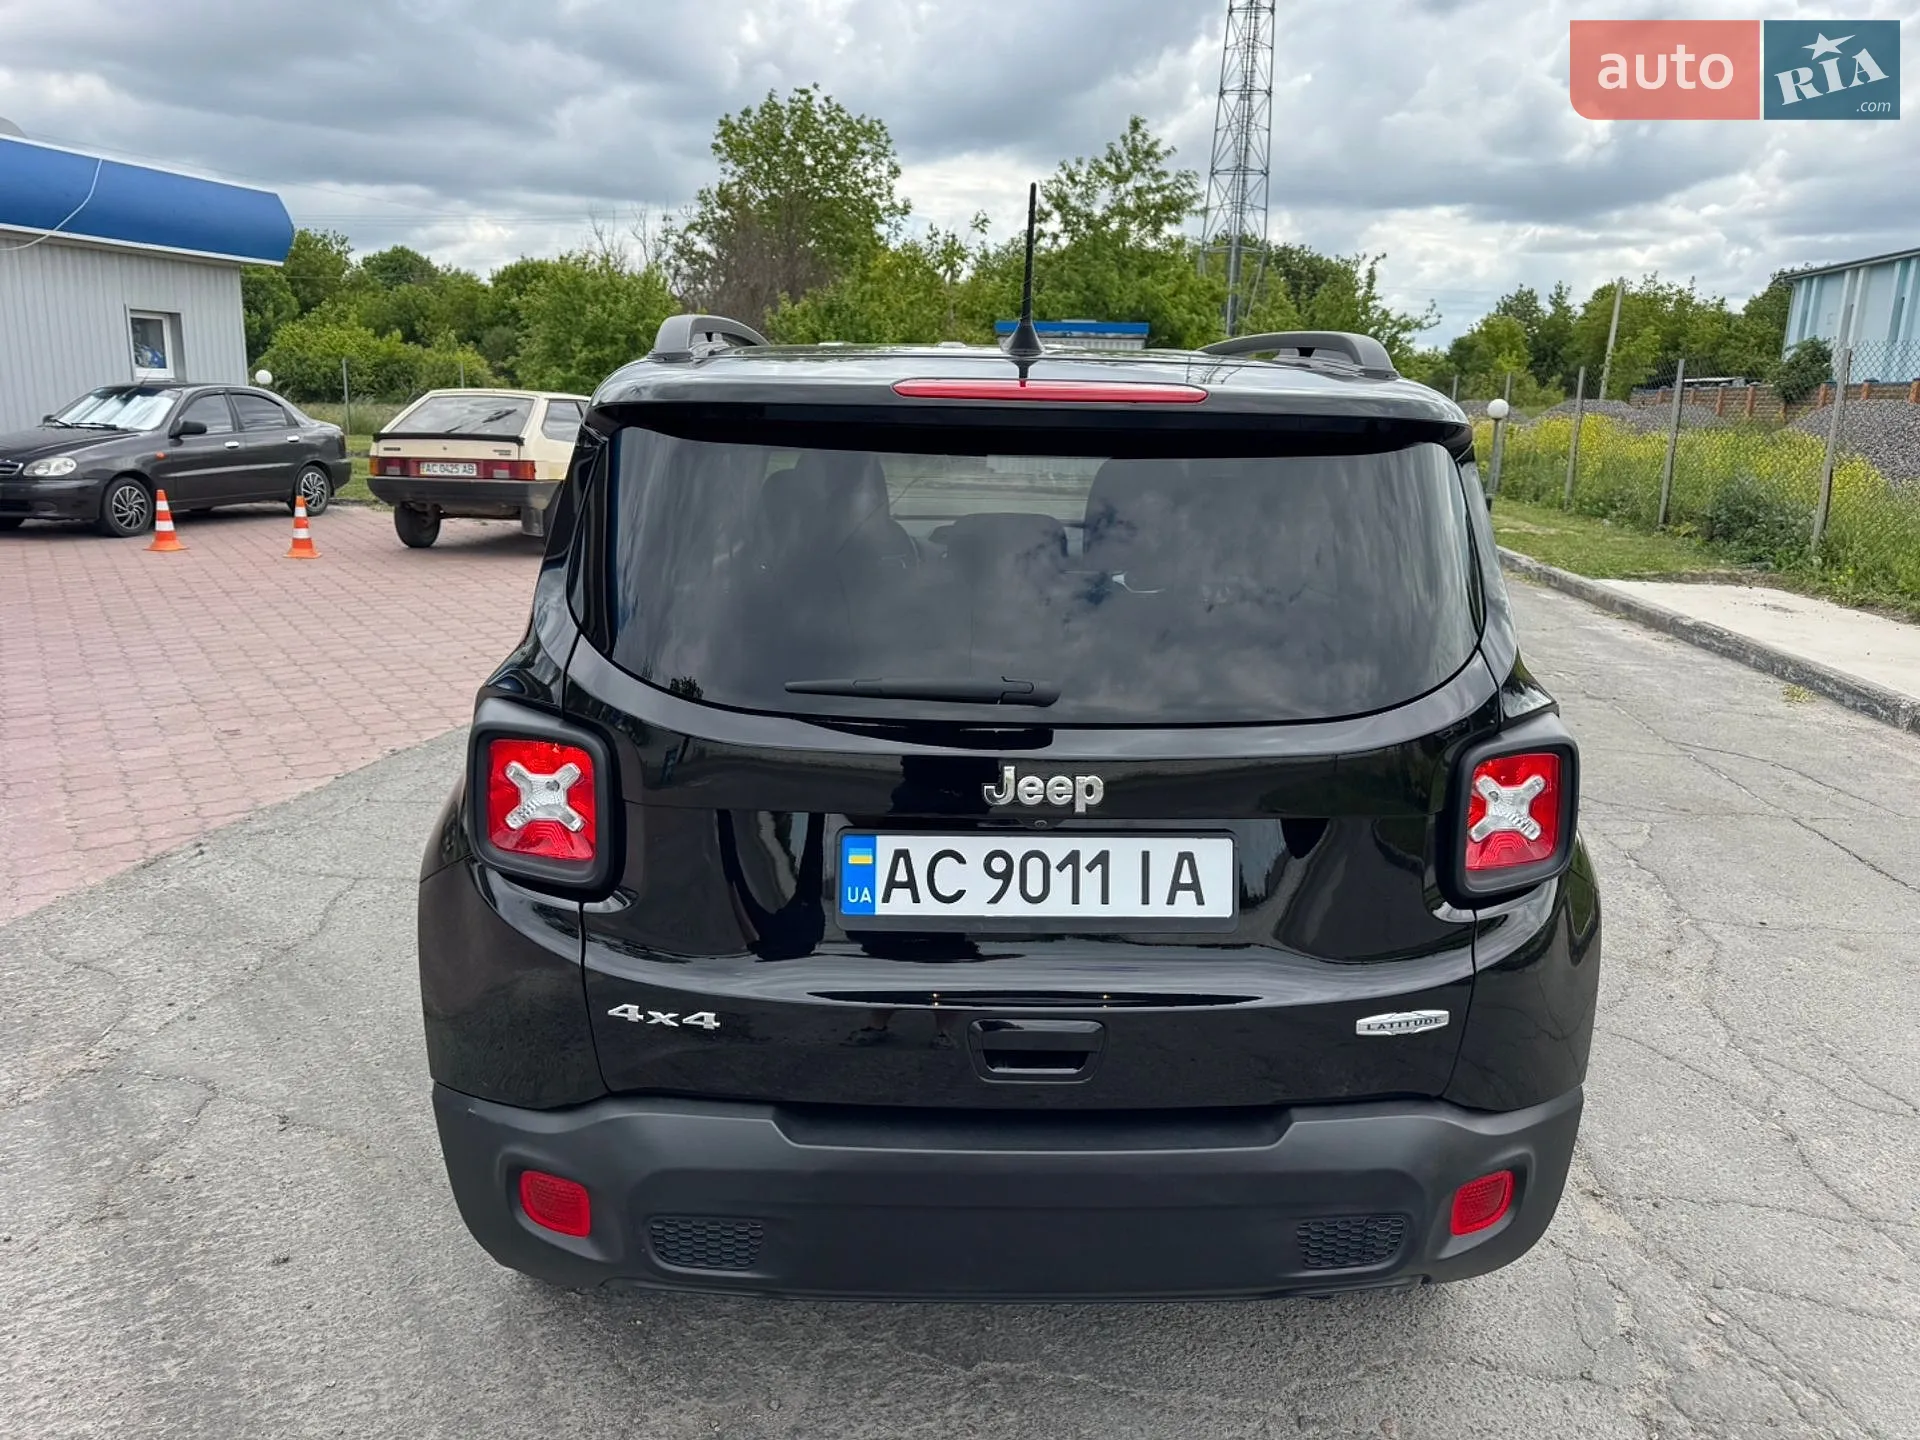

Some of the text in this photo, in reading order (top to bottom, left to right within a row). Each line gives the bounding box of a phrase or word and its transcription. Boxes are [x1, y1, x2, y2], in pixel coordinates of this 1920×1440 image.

[425, 464, 438, 474] AC
[439, 464, 460, 474] 0425
[983, 765, 1104, 813] Jeep
[881, 848, 1206, 906] AC 9011 IA
[847, 886, 873, 904] UA
[606, 1003, 721, 1030] 4x4
[1366, 1016, 1445, 1031] LATITUDE
